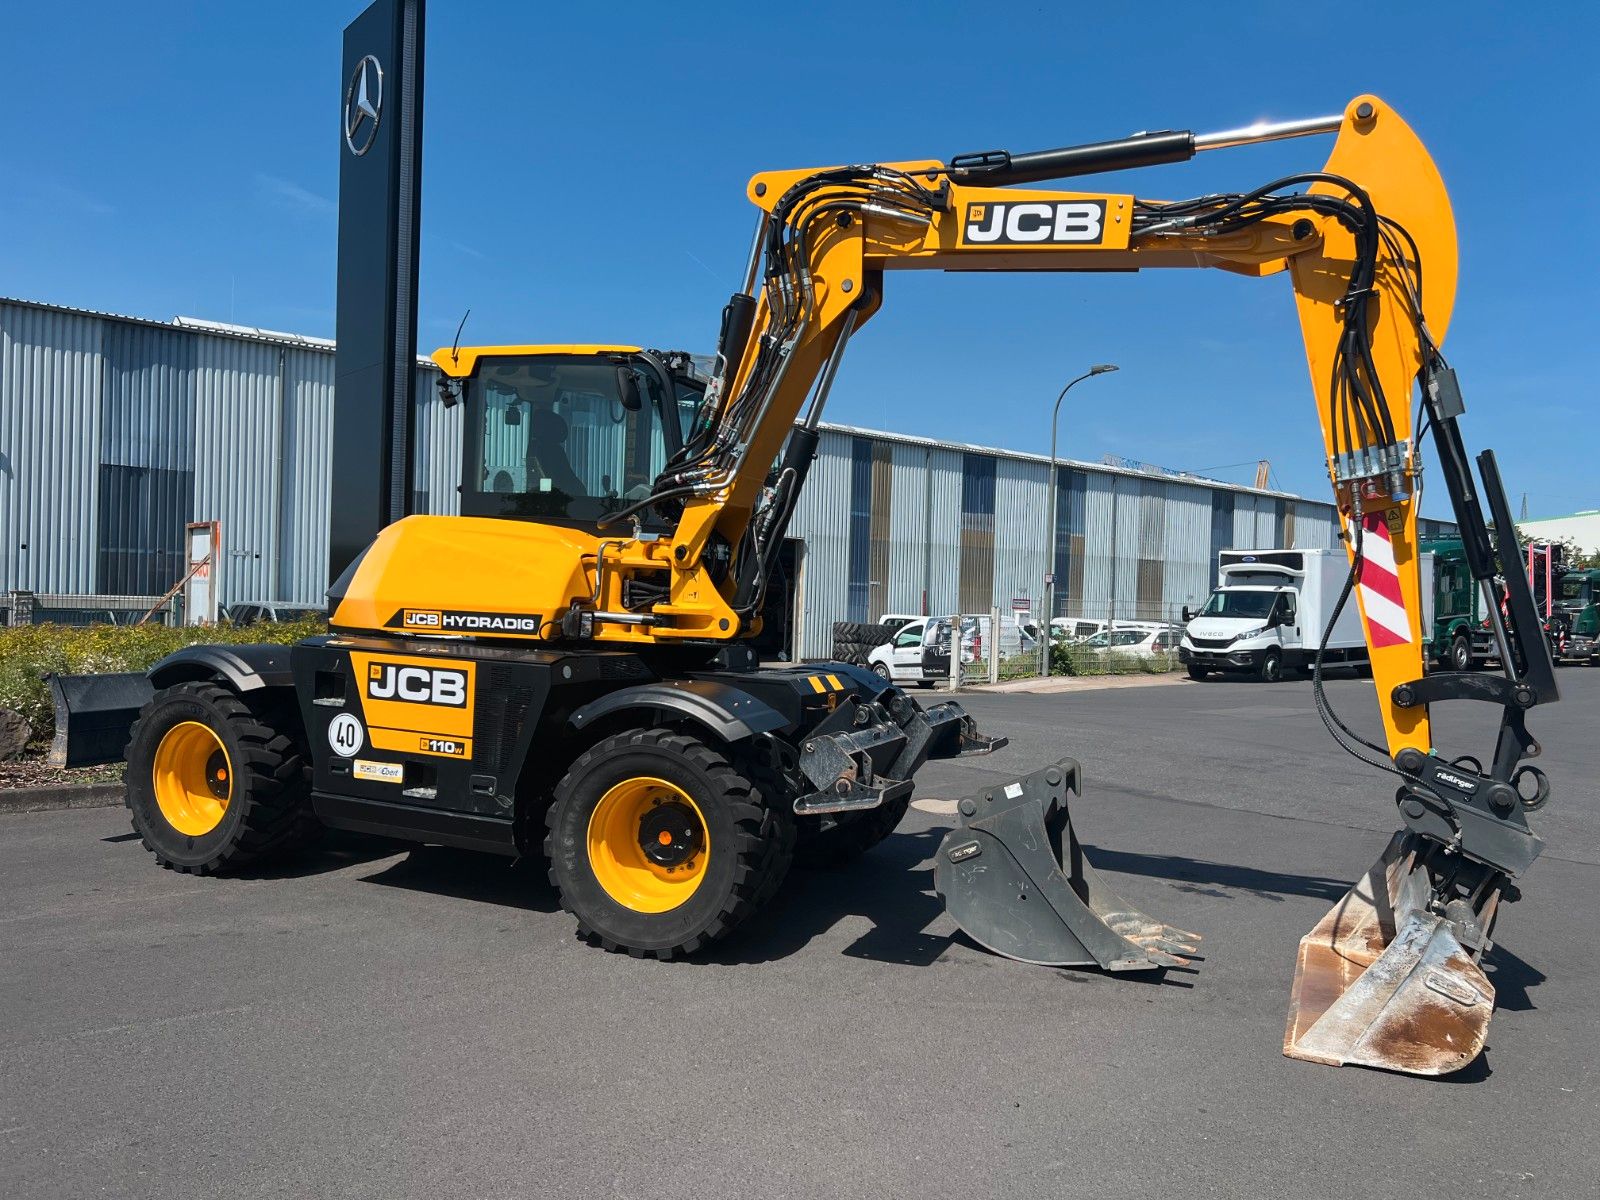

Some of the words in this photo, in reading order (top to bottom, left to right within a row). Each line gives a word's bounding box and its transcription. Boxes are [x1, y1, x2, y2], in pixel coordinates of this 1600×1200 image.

[967, 203, 1101, 241] JCB
[406, 613, 439, 625] JCB
[443, 615, 534, 630] HYDRADIG
[369, 666, 465, 705] JCB
[336, 721, 355, 748] 40
